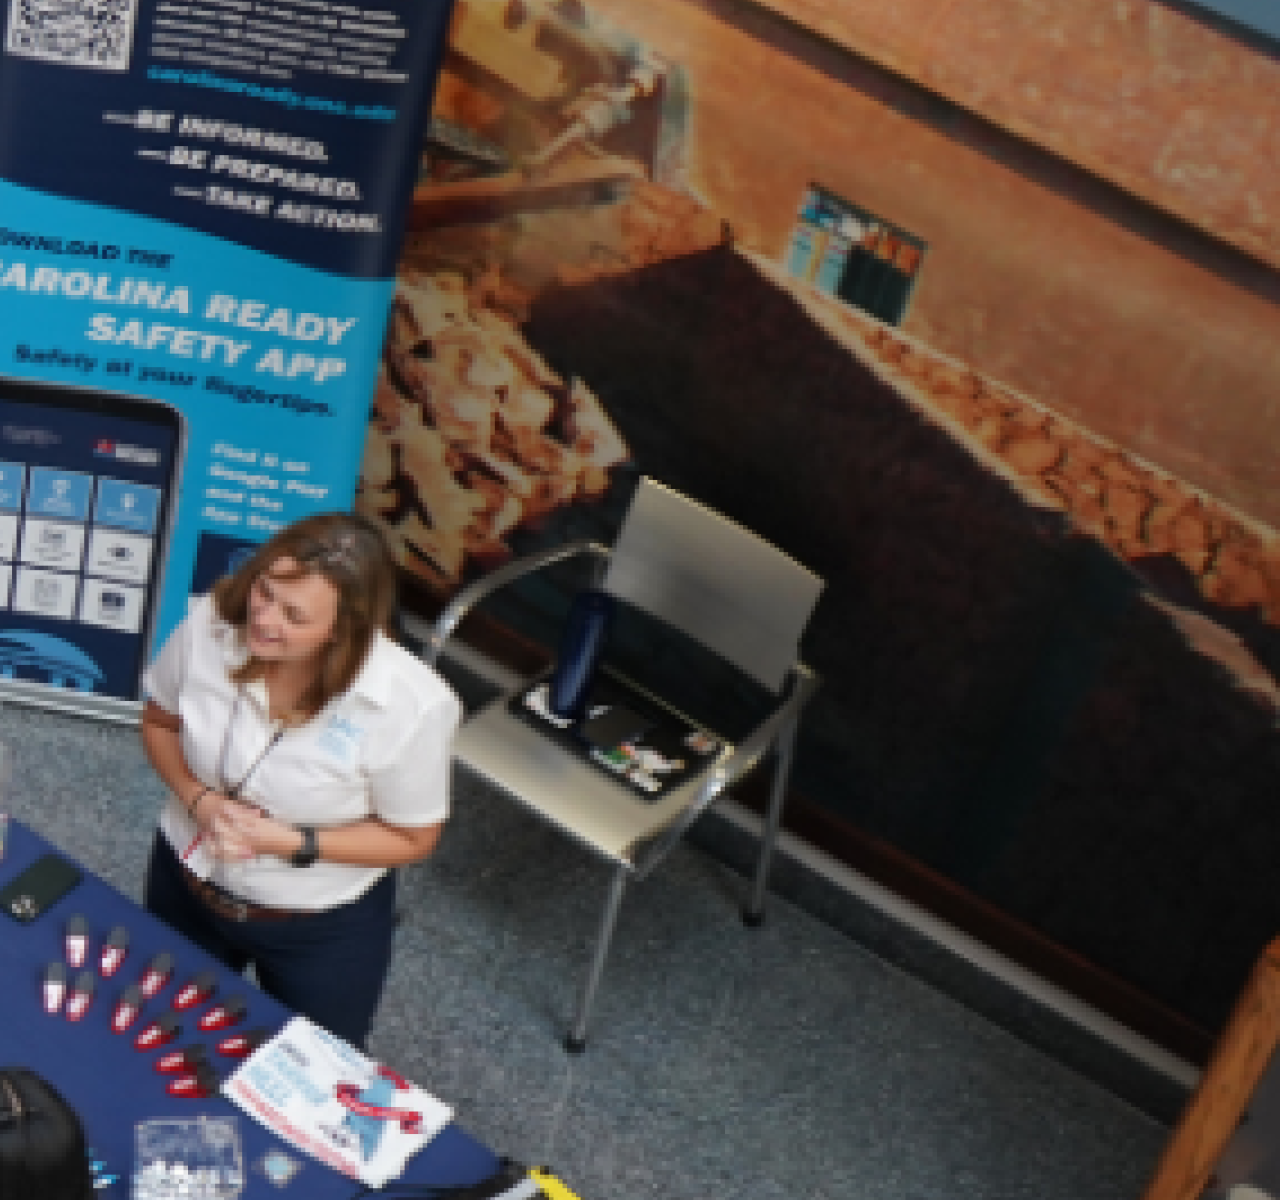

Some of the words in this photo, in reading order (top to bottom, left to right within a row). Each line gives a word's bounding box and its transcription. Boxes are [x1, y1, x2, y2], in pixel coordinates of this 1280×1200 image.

[124, 244, 176, 272] THE
[203, 291, 359, 346] READY
[13, 340, 100, 376] Safety
[103, 357, 134, 378] at
[137, 366, 198, 388] your
[84, 313, 252, 368] SAFETY
[255, 348, 348, 385] APP
[206, 462, 280, 491] Google
